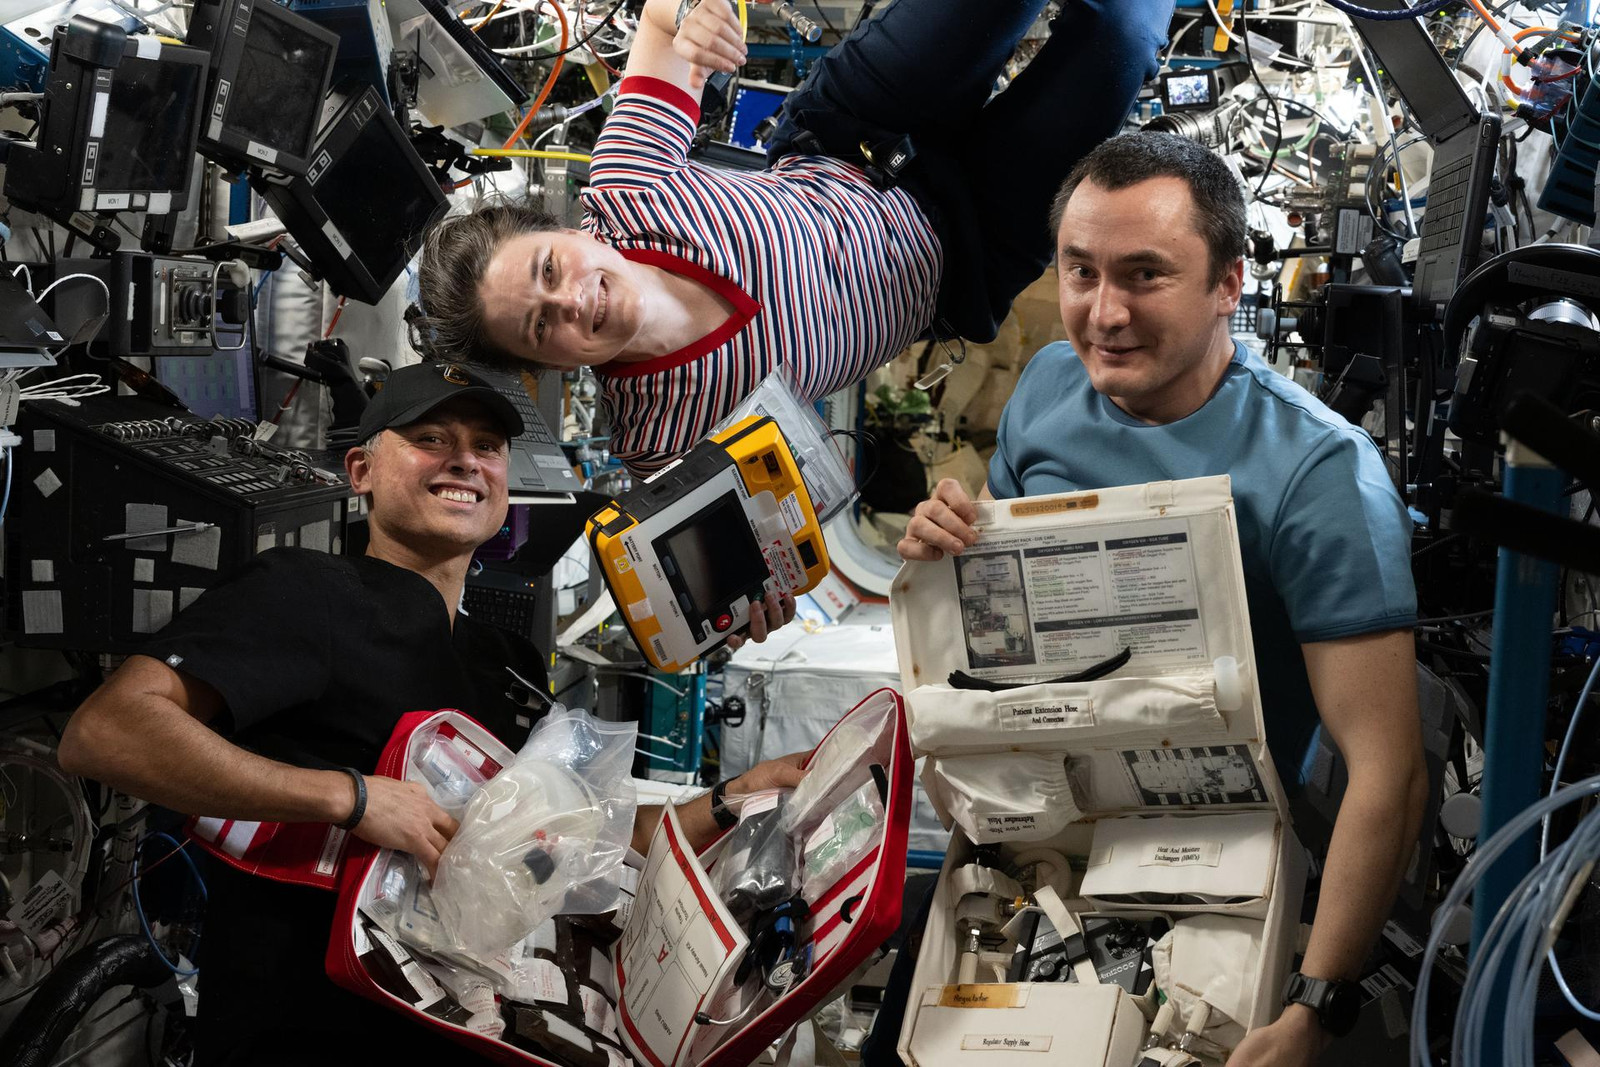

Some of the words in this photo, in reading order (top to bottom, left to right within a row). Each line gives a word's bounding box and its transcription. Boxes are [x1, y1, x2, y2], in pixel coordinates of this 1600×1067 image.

[256, 147, 265, 155] MON
[331, 233, 341, 244] MON
[730, 467, 743, 490] ELECTRODE
[753, 527, 762, 544] DISPLAY
[627, 535, 638, 553] BATTERY
[634, 551, 642, 562] PORT
[786, 546, 796, 561] STATUS
[792, 559, 802, 575] DISPLAY
[652, 563, 662, 578] BUTTON
[668, 599, 678, 614] BUTTON
[1012, 707, 1032, 715] Patient
[1034, 705, 1062, 714] Extension
[1064, 704, 1078, 712] Hose
[986, 816, 1002, 824] Mask
[1154, 854, 1179, 862] Exchangers
[953, 992, 988, 1004] Regulator
[982, 1037, 1002, 1046] Regulator
[1002, 1037, 1018, 1047] Supply
[1019, 1038, 1030, 1046] Hose
